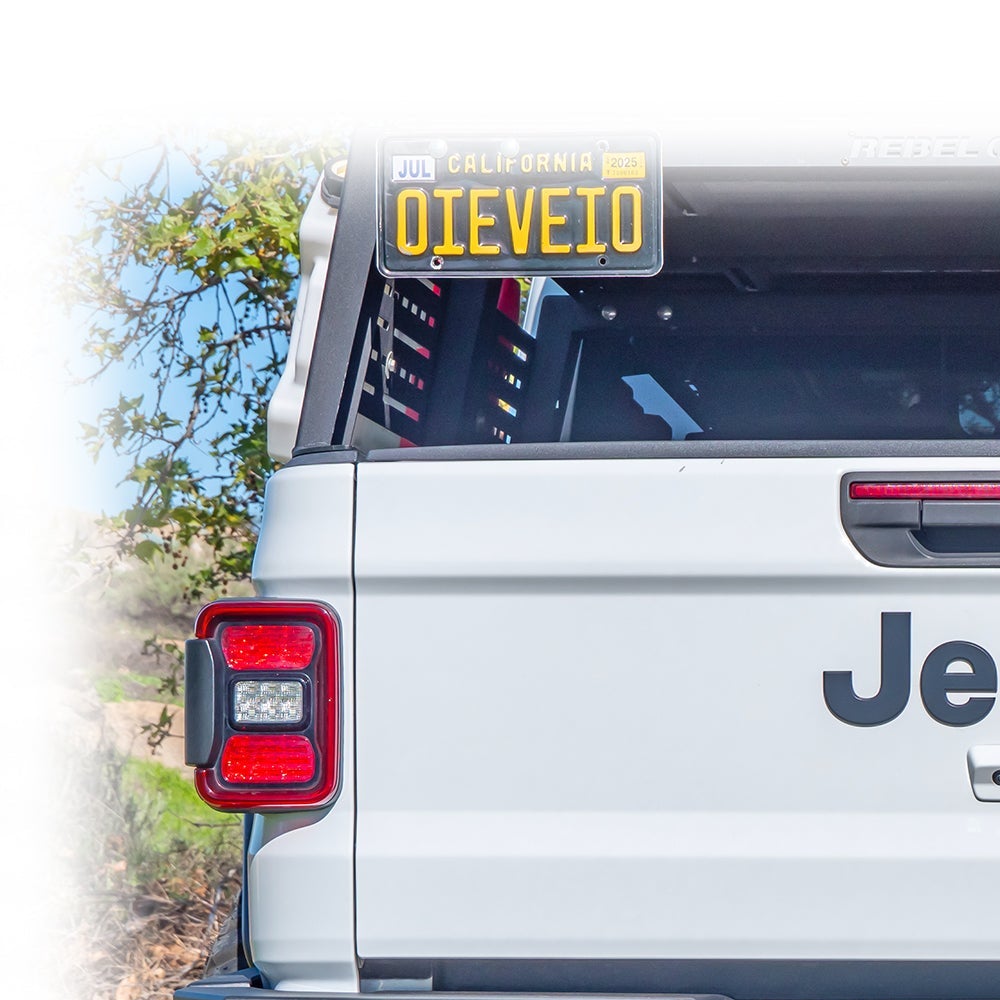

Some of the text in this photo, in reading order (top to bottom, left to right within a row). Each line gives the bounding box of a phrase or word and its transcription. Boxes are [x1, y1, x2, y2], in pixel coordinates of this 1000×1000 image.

[398, 159, 432, 178] JUL
[448, 152, 594, 175] CALIFORNIA
[610, 156, 638, 169] 2025
